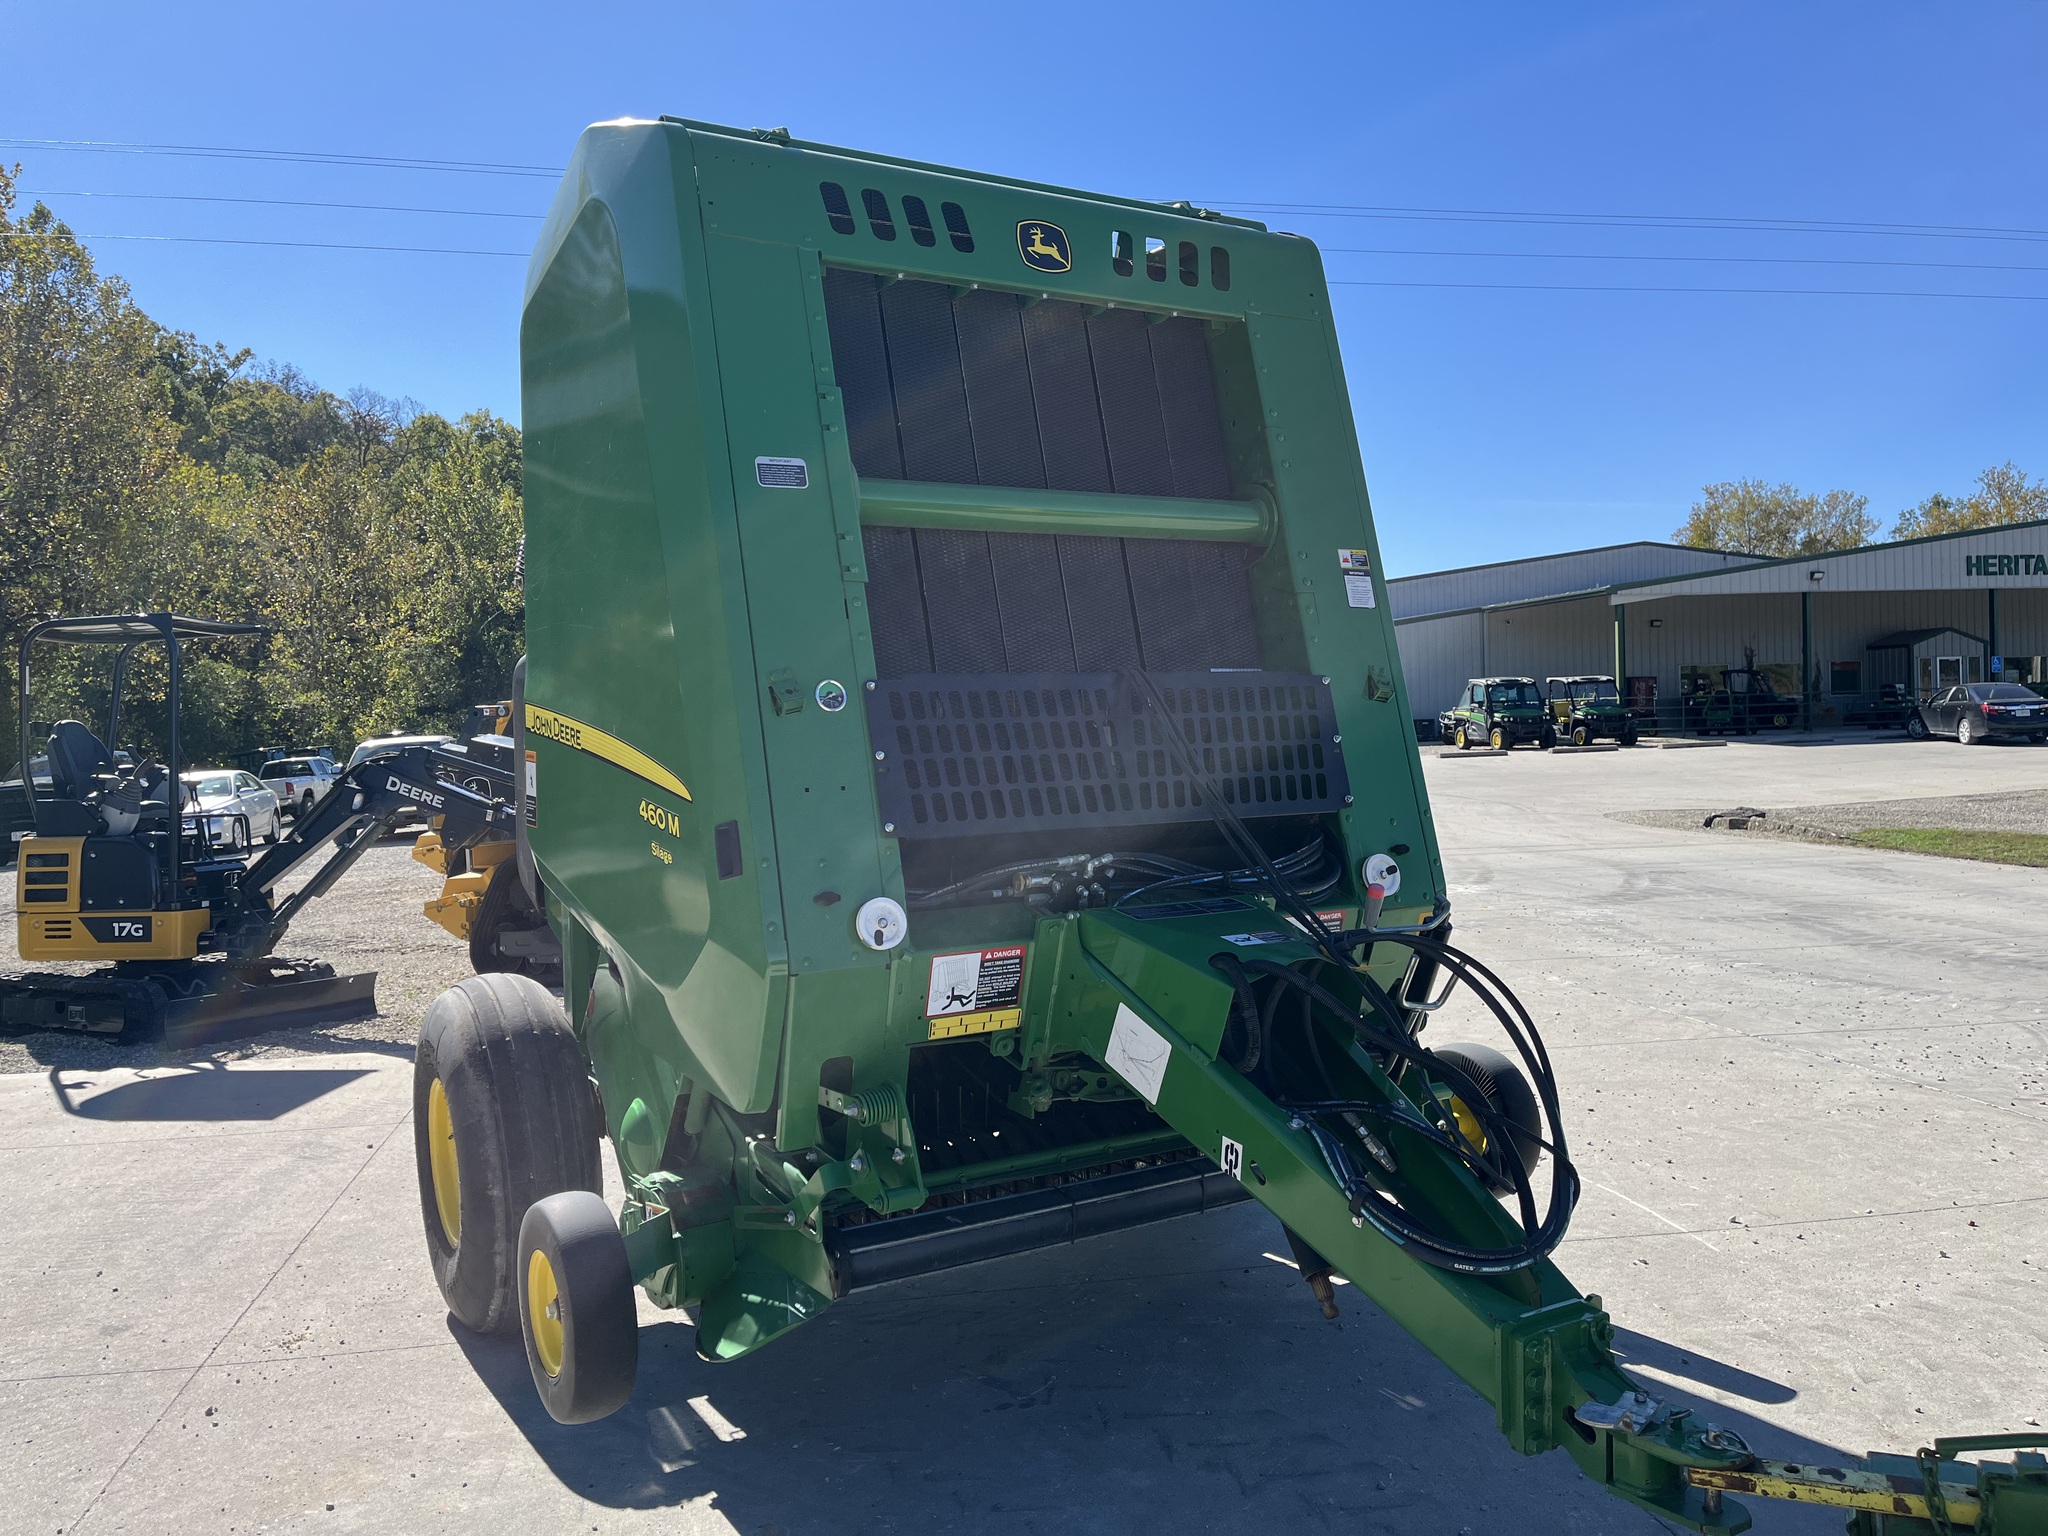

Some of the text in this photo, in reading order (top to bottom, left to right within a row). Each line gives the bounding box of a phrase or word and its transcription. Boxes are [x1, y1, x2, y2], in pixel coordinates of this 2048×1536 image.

[1966, 555, 2048, 576] HERITA
[531, 711, 581, 747] JOHN DEERE
[386, 776, 445, 808] DEERE
[638, 800, 680, 838] 460 M
[651, 842, 673, 864] Silage
[112, 922, 143, 937] 17G
[993, 949, 1020, 958] DANGER
[1454, 1263, 1474, 1271] GATES
